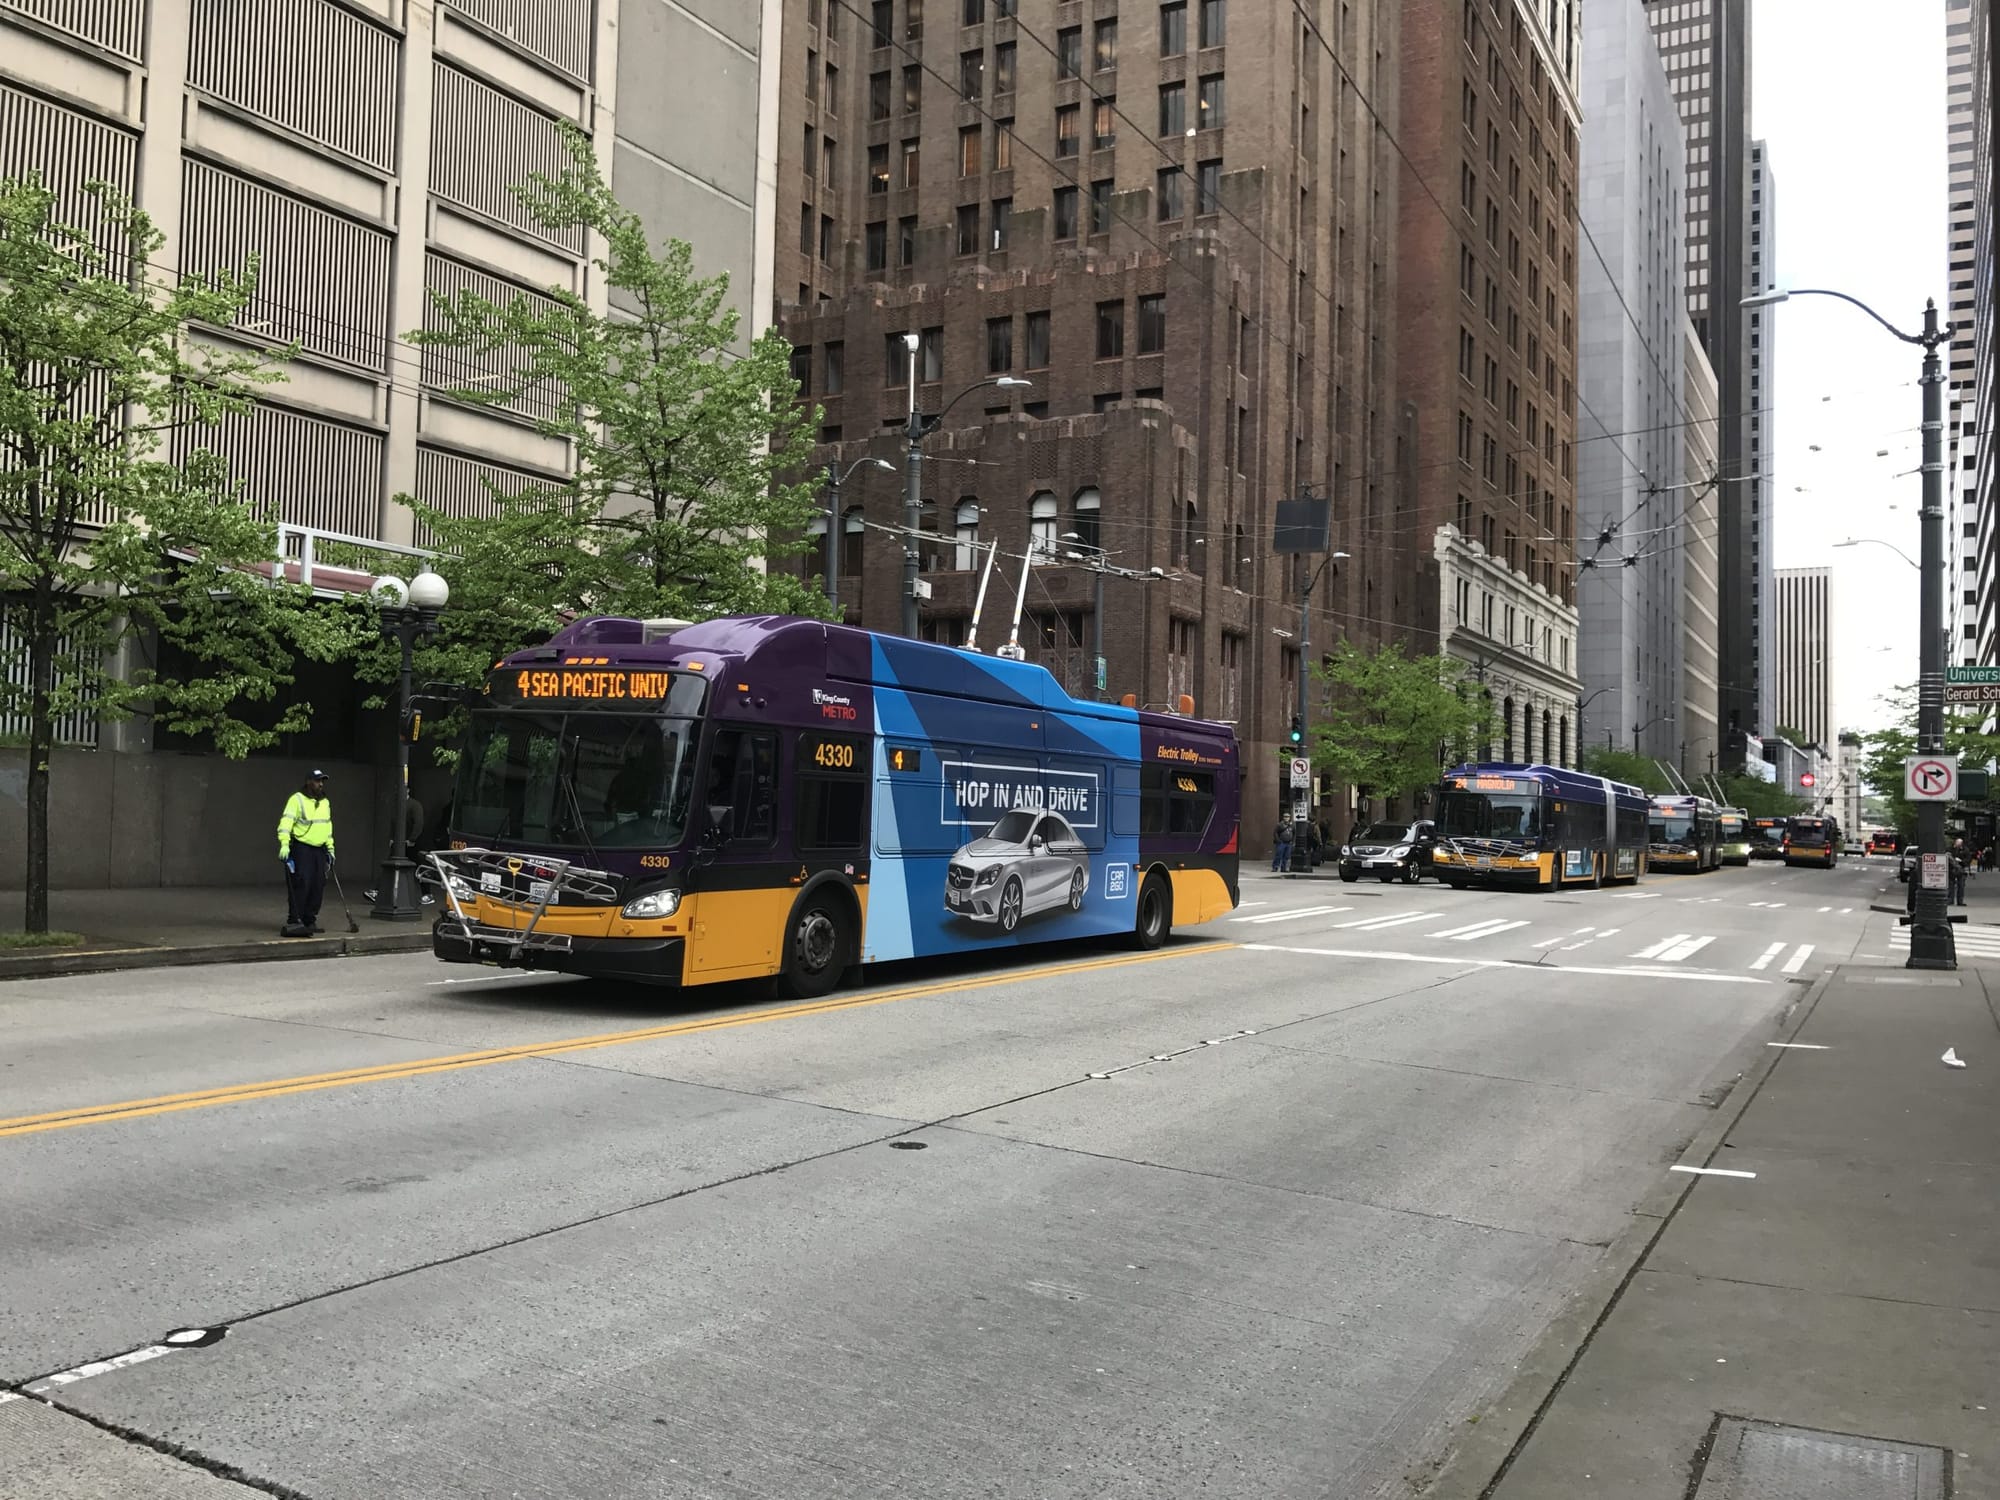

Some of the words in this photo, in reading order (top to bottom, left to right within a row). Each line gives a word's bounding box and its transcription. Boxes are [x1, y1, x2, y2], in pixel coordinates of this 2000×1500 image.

[517, 671, 530, 698] 4
[532, 673, 559, 697] SEA
[562, 672, 626, 698] PACIFIC
[629, 673, 669, 698] UNIV
[822, 693, 834, 704] King
[834, 695, 850, 706] County
[1946, 687, 1979, 700] Gerard
[822, 705, 857, 720] METRO
[815, 743, 853, 768] 4330
[894, 750, 904, 770] 4
[1157, 745, 1179, 761] Electric
[1180, 748, 1200, 765] Trolley
[955, 780, 990, 808] HOP
[993, 782, 1010, 809] IN
[1012, 784, 1044, 810] AND
[1048, 786, 1089, 812] DRIVE
[639, 855, 670, 869] 4330
[1110, 870, 1124, 881] CAR
